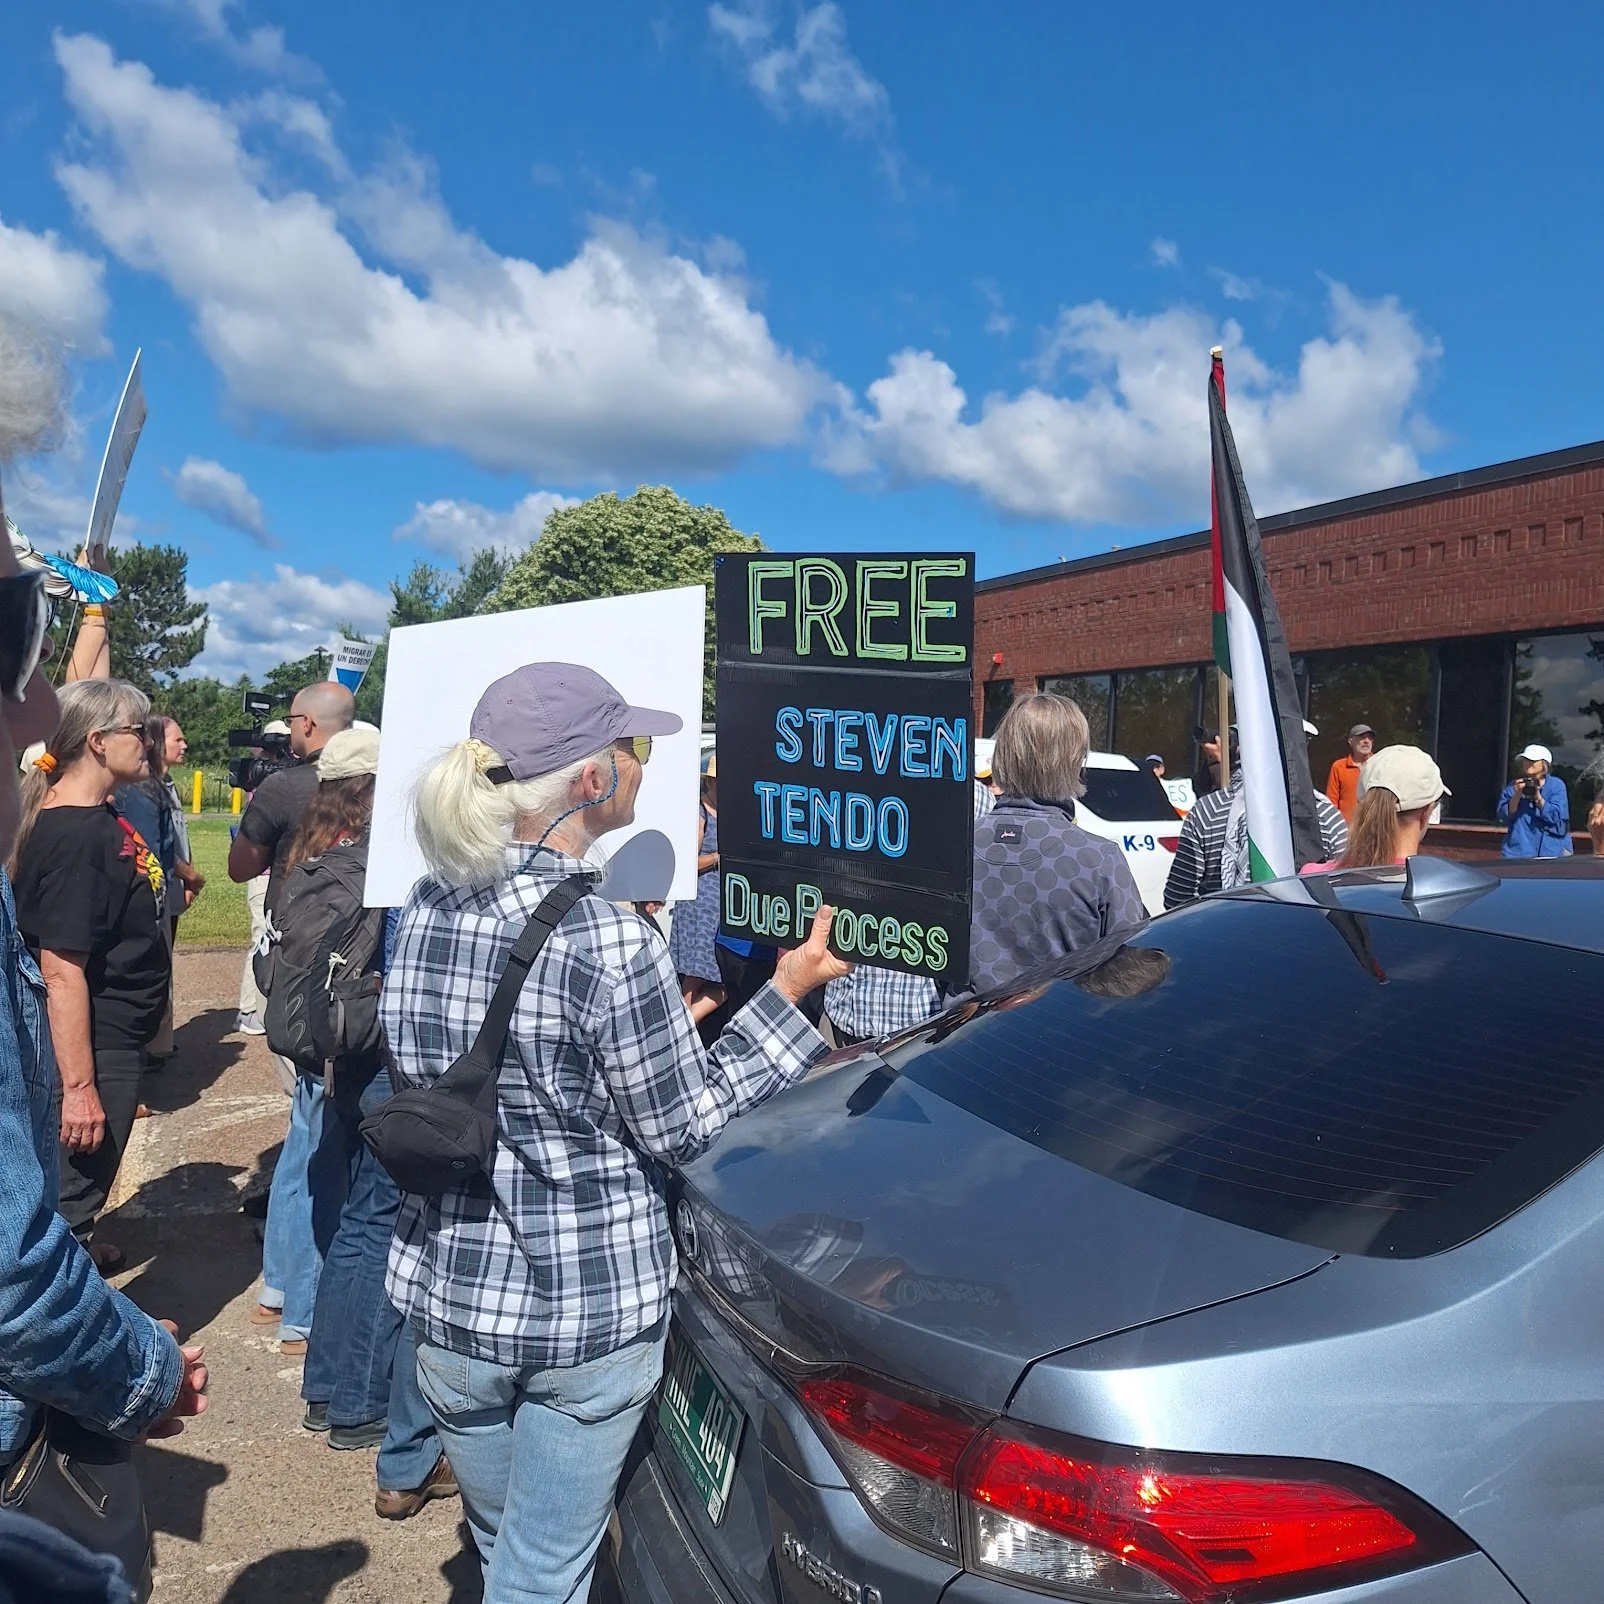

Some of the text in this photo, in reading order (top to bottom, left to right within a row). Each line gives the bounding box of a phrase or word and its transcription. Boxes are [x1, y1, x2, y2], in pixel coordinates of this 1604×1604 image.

[747, 558, 967, 662] FREE
[337, 654, 347, 662] UN
[343, 646, 366, 656] MIGRAR
[775, 706, 967, 782] STEVEN
[753, 781, 909, 859] TENDO
[1122, 834, 1156, 852] K-9
[725, 873, 791, 938] Due
